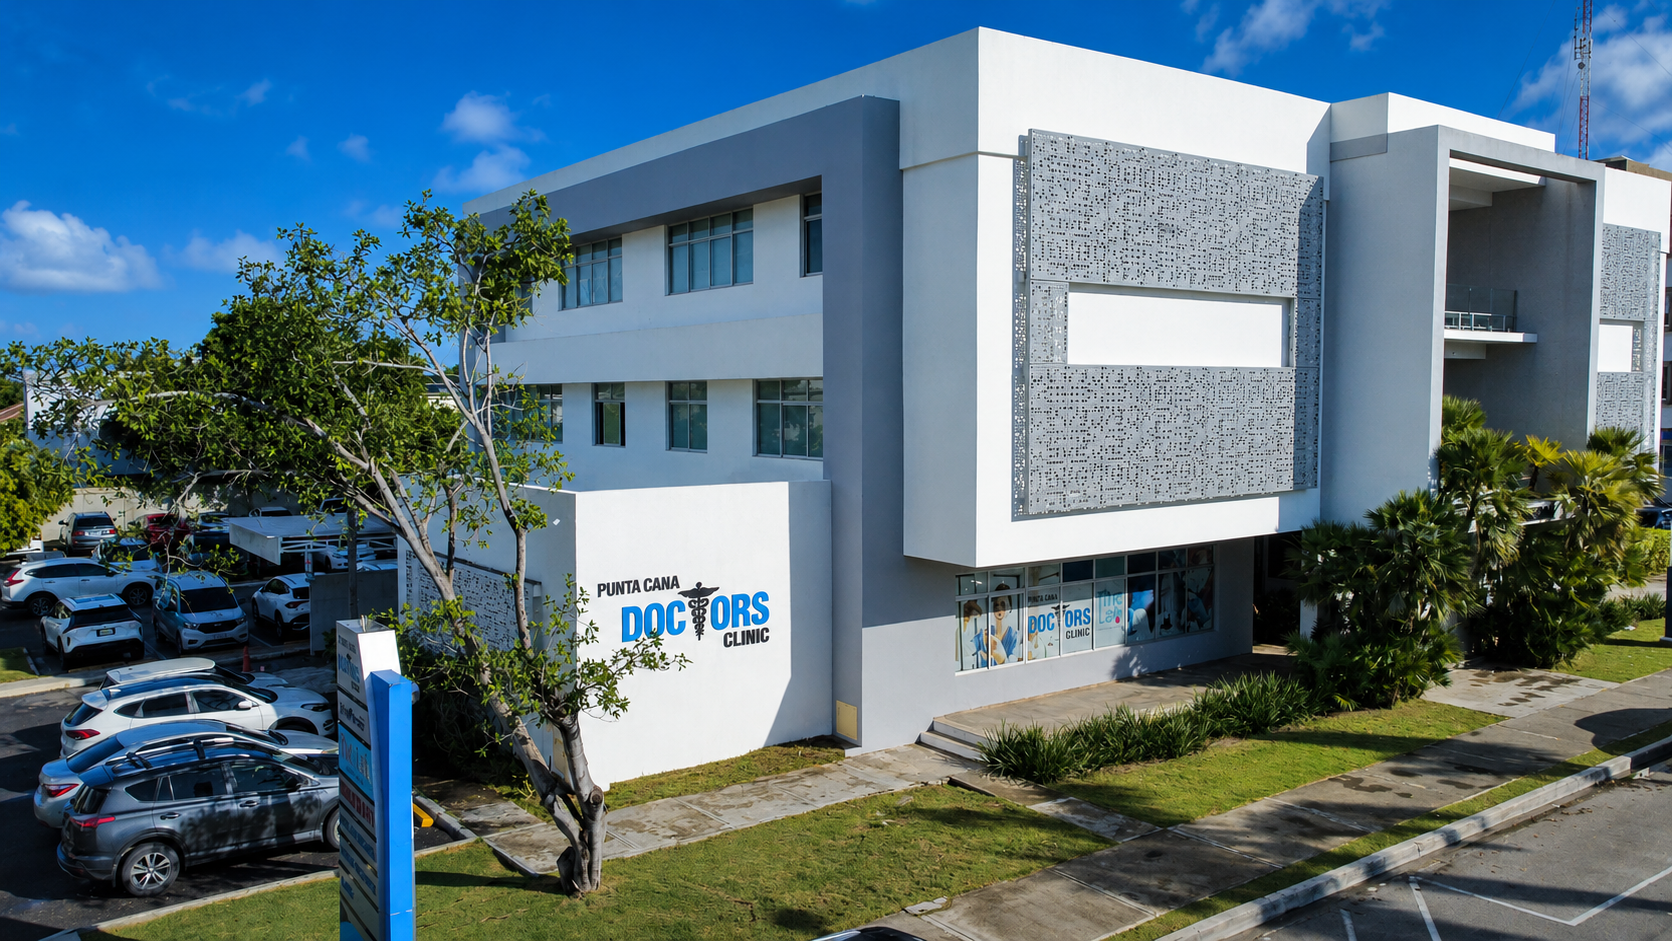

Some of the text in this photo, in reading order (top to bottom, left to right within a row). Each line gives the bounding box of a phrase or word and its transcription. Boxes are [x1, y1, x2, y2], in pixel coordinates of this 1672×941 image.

[597, 575, 680, 598] PUNTA CANA
[723, 627, 770, 648] CLINIC
[1065, 627, 1091, 640] CLINIC
